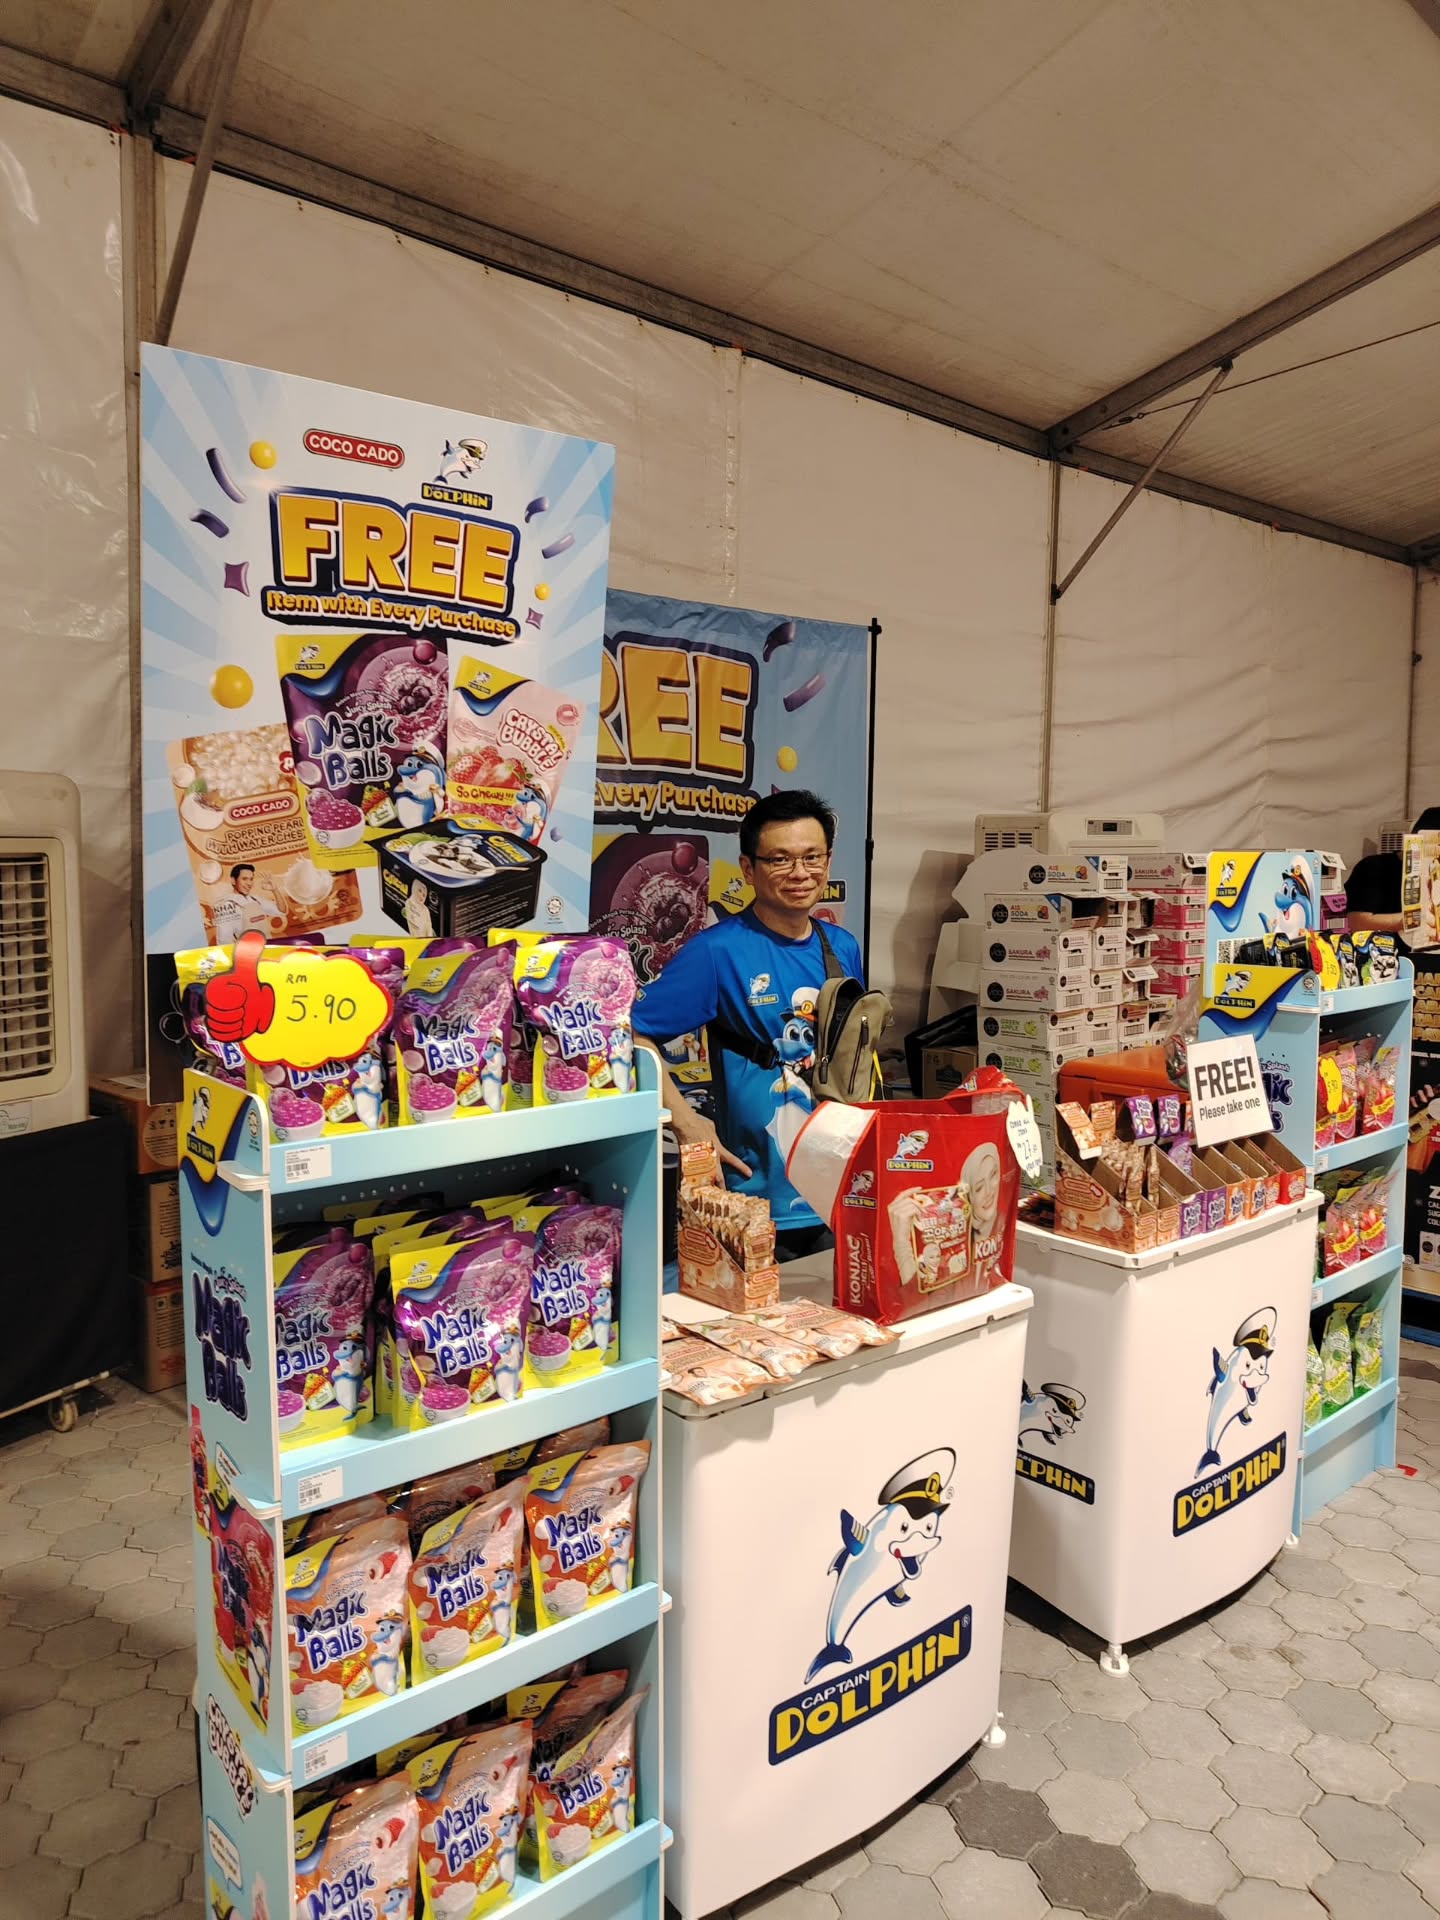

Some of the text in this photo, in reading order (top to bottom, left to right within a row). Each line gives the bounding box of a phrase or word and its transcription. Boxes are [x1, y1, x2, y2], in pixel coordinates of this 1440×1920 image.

[309, 434, 400, 465] COCO CADO
[278, 494, 514, 608] FREE
[267, 590, 517, 639] Item with Every Purchase
[366, 701, 392, 712] Splash
[306, 713, 396, 755] Magic
[501, 724, 555, 772] BUBBLE
[506, 709, 564, 763] CRYSTAL
[326, 752, 389, 787] Balls
[232, 800, 290, 818] COCO CADO
[456, 785, 469, 799] So
[228, 825, 271, 840] POPPING
[242, 834, 275, 848] WATER
[621, 925, 647, 938] Splash
[286, 994, 357, 1025] 5.90
[545, 1001, 601, 1029] Magic
[413, 1013, 476, 1045] Magic
[562, 1028, 603, 1057] Balls
[428, 1043, 476, 1074] Balls
[1267, 1061, 1290, 1073] Splash
[1194, 1056, 1257, 1101] FREE!
[1200, 1096, 1261, 1121] Please take one
[532, 1261, 586, 1299] Magic
[848, 1233, 861, 1305] KONJAC
[542, 1290, 586, 1323] Balls
[422, 1306, 487, 1350] Magic
[440, 1341, 489, 1374] Balls
[1192, 1472, 1232, 1498] CAPTAIN
[546, 1505, 604, 1547] Magic
[560, 1535, 603, 1570] Balls
[426, 1550, 486, 1595] Magic
[440, 1576, 485, 1618] Balls
[294, 1591, 366, 1642] Magic
[309, 1626, 362, 1670] Balls
[801, 1669, 870, 1710] CAPTAIN
[435, 1792, 490, 1850] Magic
[450, 1824, 491, 1873] Balls
[309, 1863, 375, 1920] Magic
